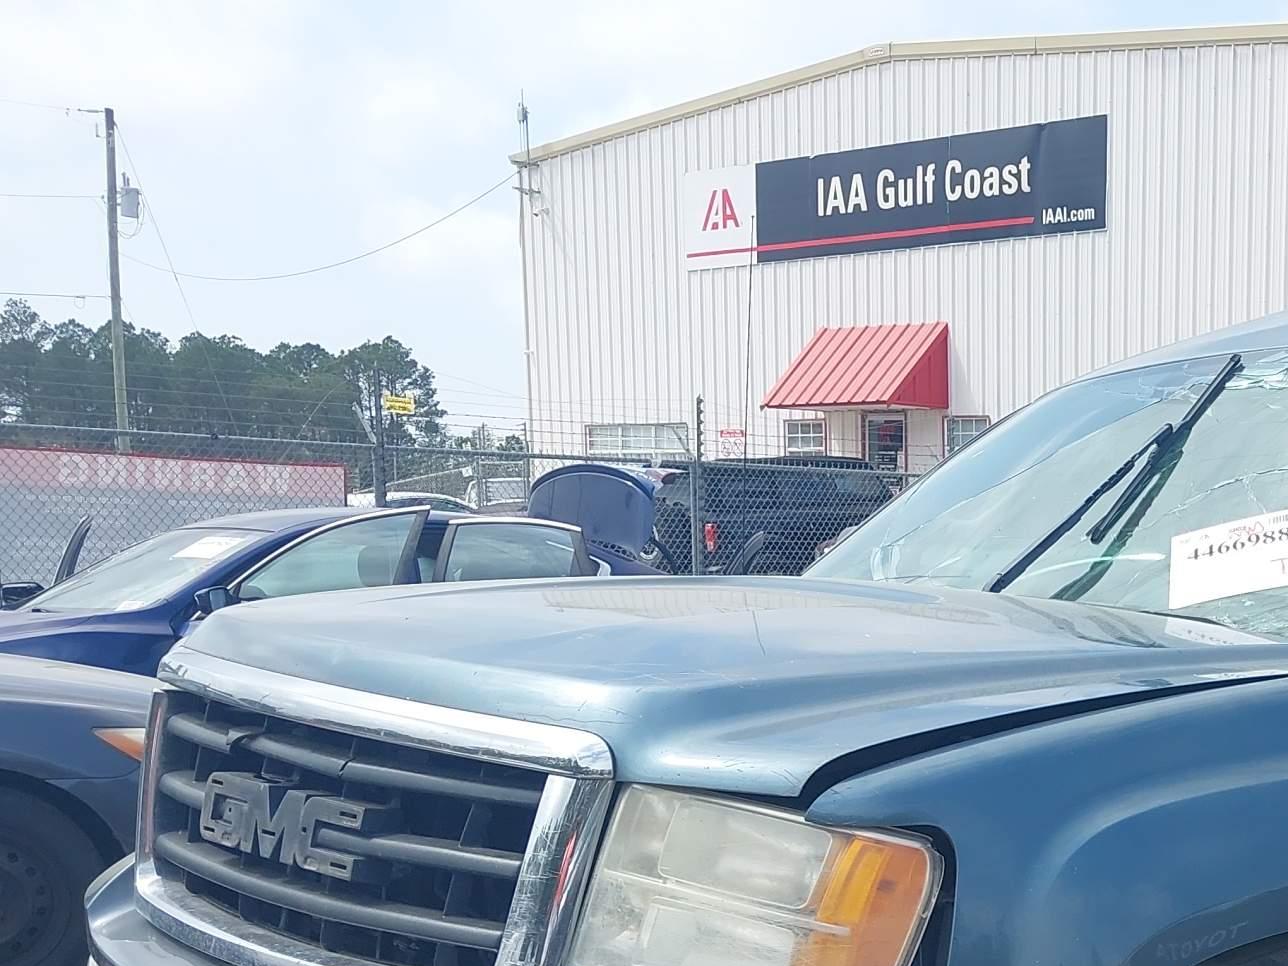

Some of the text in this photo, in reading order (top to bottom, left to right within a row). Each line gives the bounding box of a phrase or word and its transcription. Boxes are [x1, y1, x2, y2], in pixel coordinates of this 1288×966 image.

[817, 155, 1031, 217] IAA Gulf Coast
[1042, 206, 1095, 225] IAAI.com
[200, 771, 366, 882] GMC
